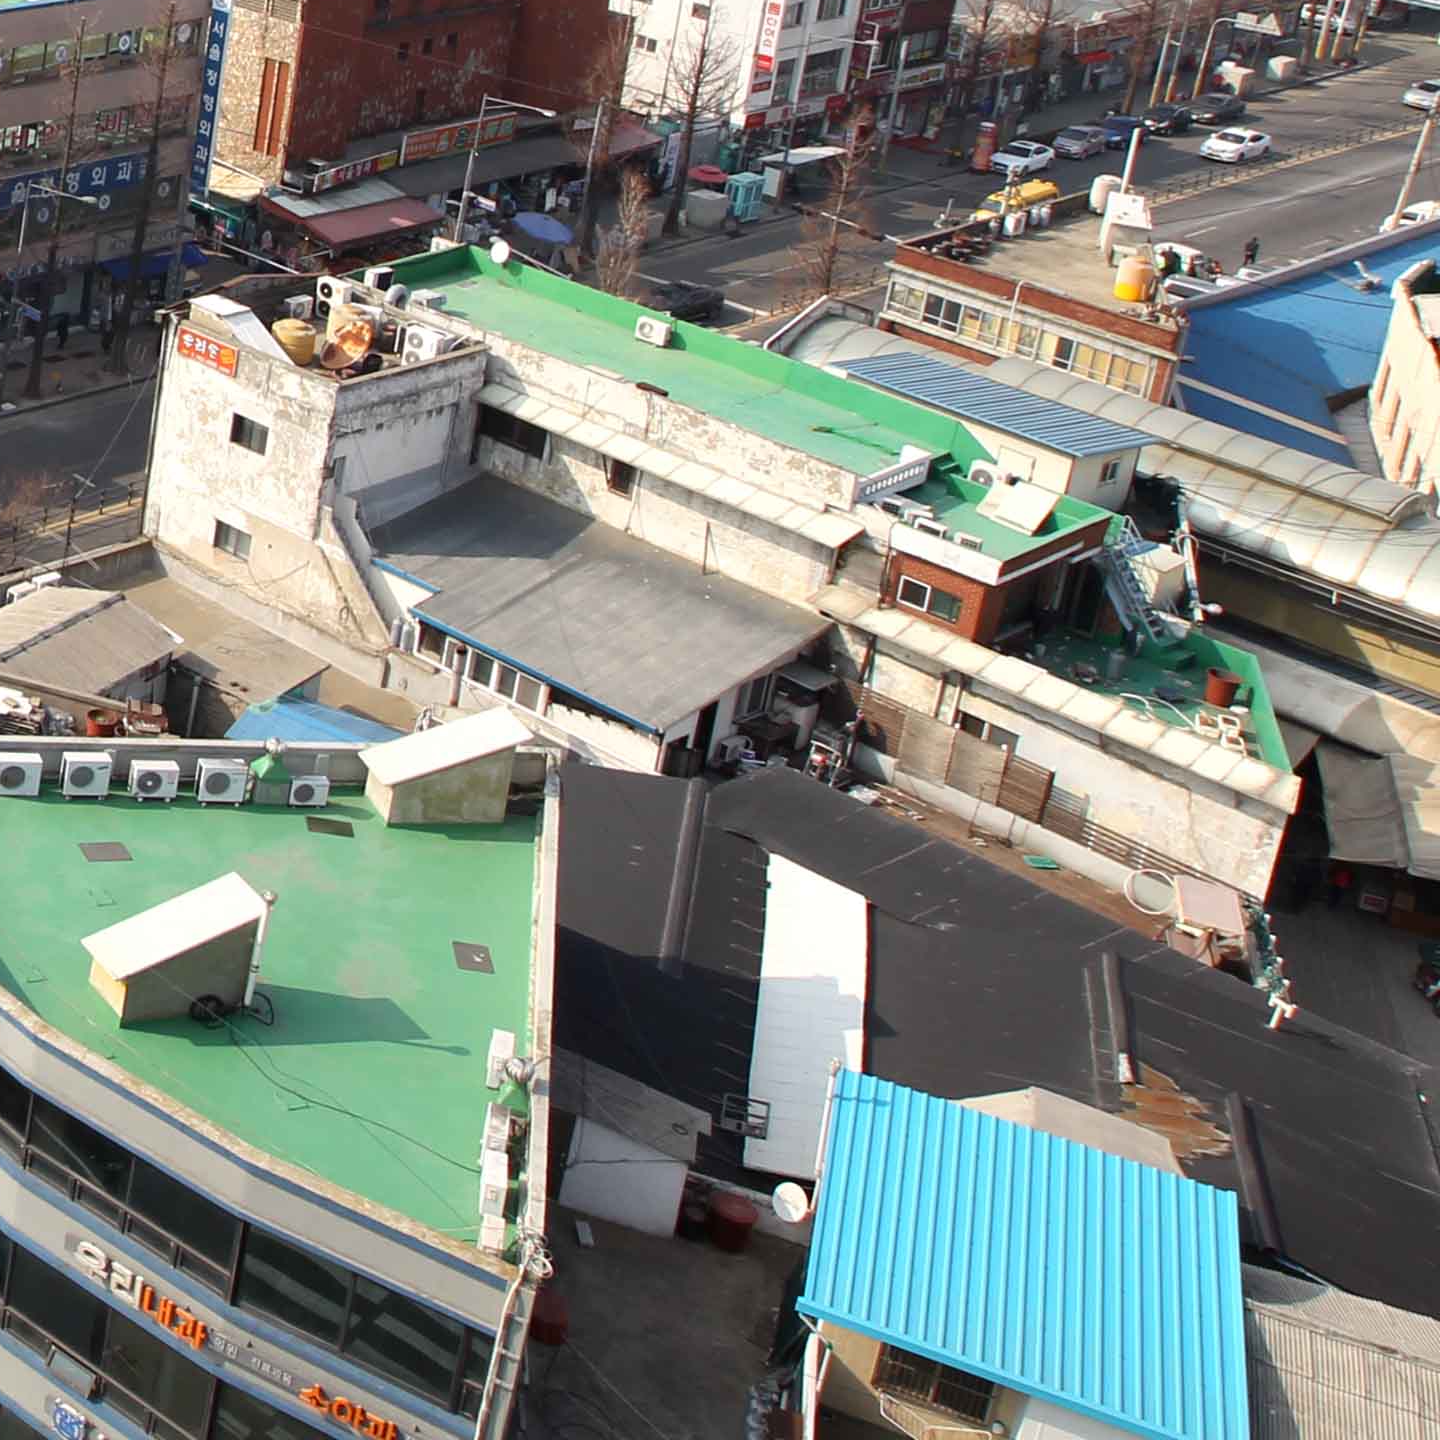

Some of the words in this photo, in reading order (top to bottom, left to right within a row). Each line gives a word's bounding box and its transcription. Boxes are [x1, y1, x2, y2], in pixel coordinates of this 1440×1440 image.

[194, 21, 225, 160] 서울정형외과
[72, 1239, 208, 1352] 우리내과
[297, 1383, 398, 1440] 소아과
